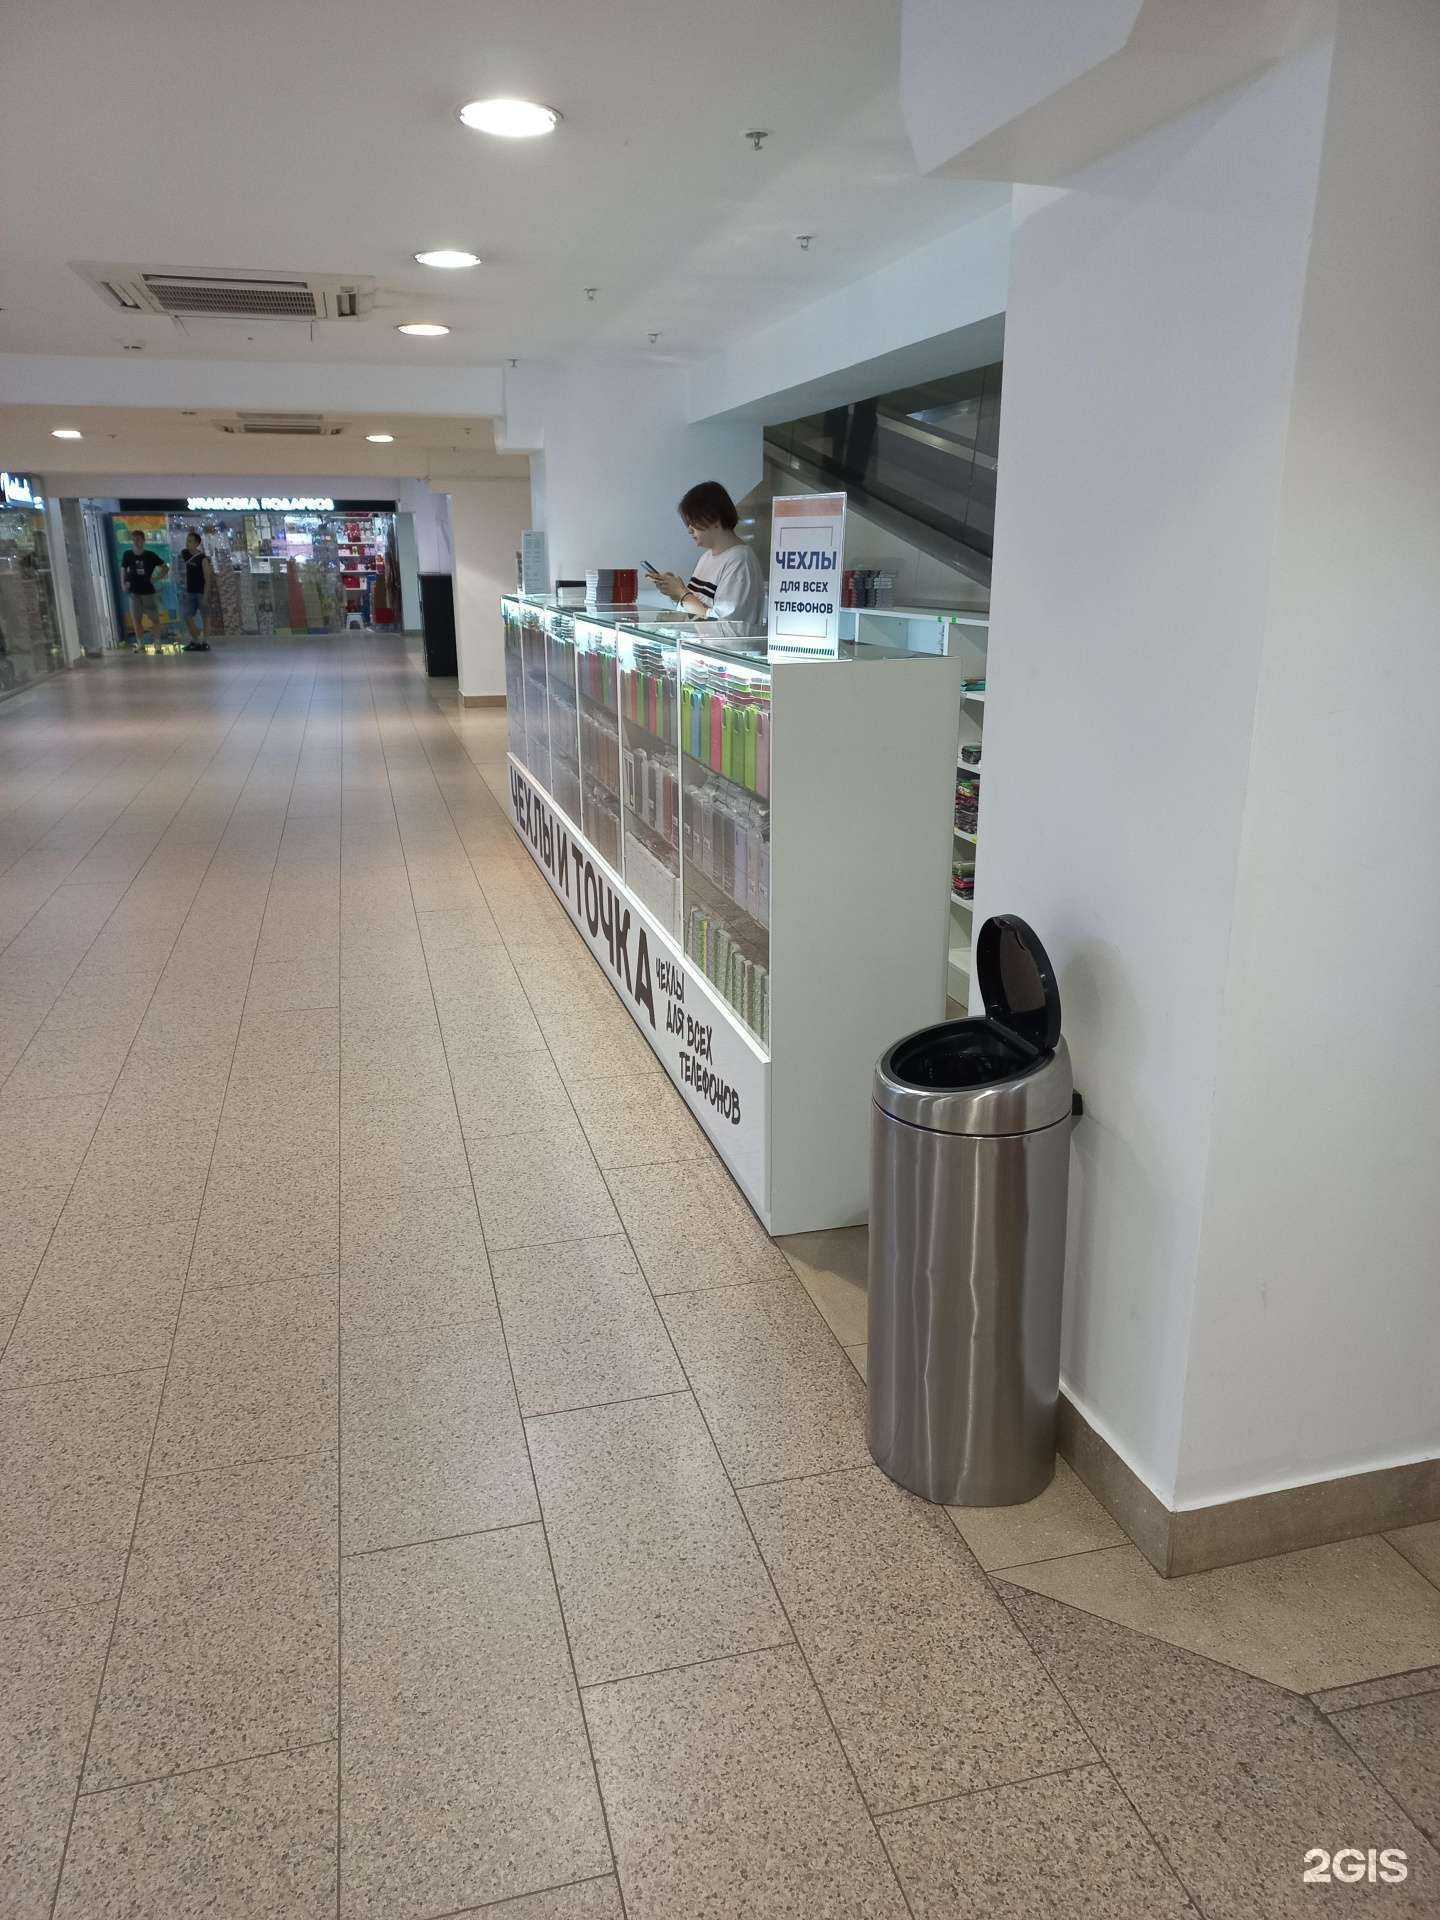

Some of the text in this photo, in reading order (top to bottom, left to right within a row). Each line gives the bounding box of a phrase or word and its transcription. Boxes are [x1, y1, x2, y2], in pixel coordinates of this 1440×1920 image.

[775, 551, 837, 570] ЧЕХЛЫ
[774, 601, 833, 614] ТЕЛЕФОНОВ
[780, 581, 829, 593] ДЛЯ ВСЕХ
[510, 765, 656, 1031] ЧЕХЛЫ И ТОЧКА
[656, 957, 685, 1003] ЧЕХЛЫ
[666, 1000, 713, 1065] ДЛЯ ВСЕХ
[679, 1051, 741, 1125] ТЕЛЕФОНОВ
